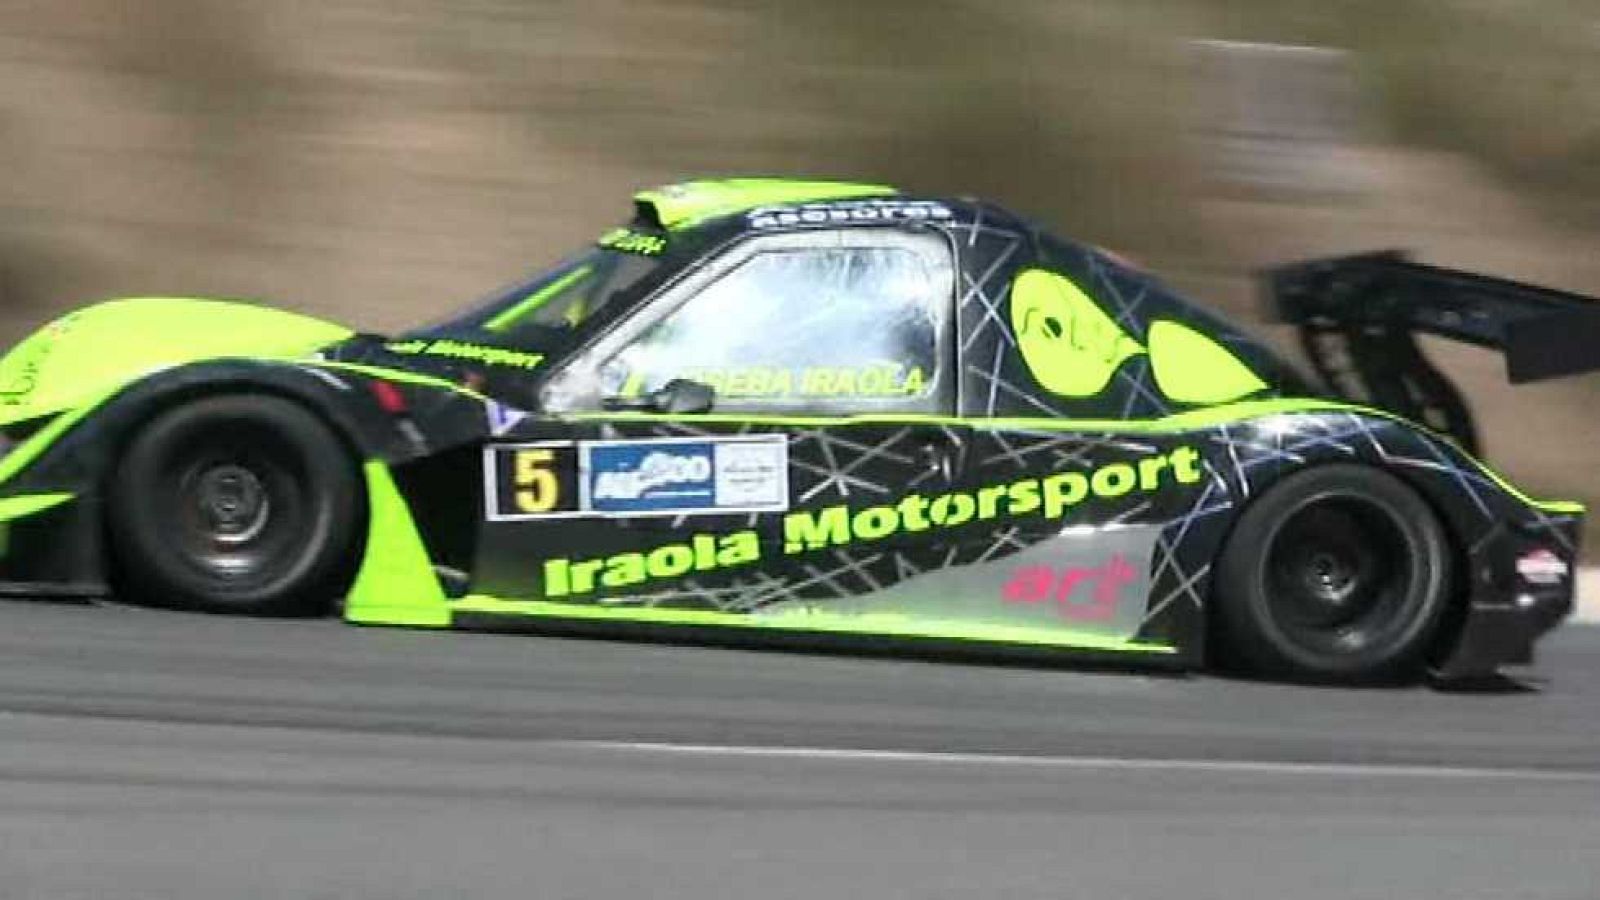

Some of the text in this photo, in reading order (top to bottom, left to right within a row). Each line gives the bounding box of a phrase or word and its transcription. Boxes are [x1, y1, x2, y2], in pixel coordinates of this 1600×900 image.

[804, 365, 924, 396] IRAOLA
[513, 449, 558, 513] 5
[544, 531, 760, 597] Iraola
[784, 446, 1200, 554] Motorsport
